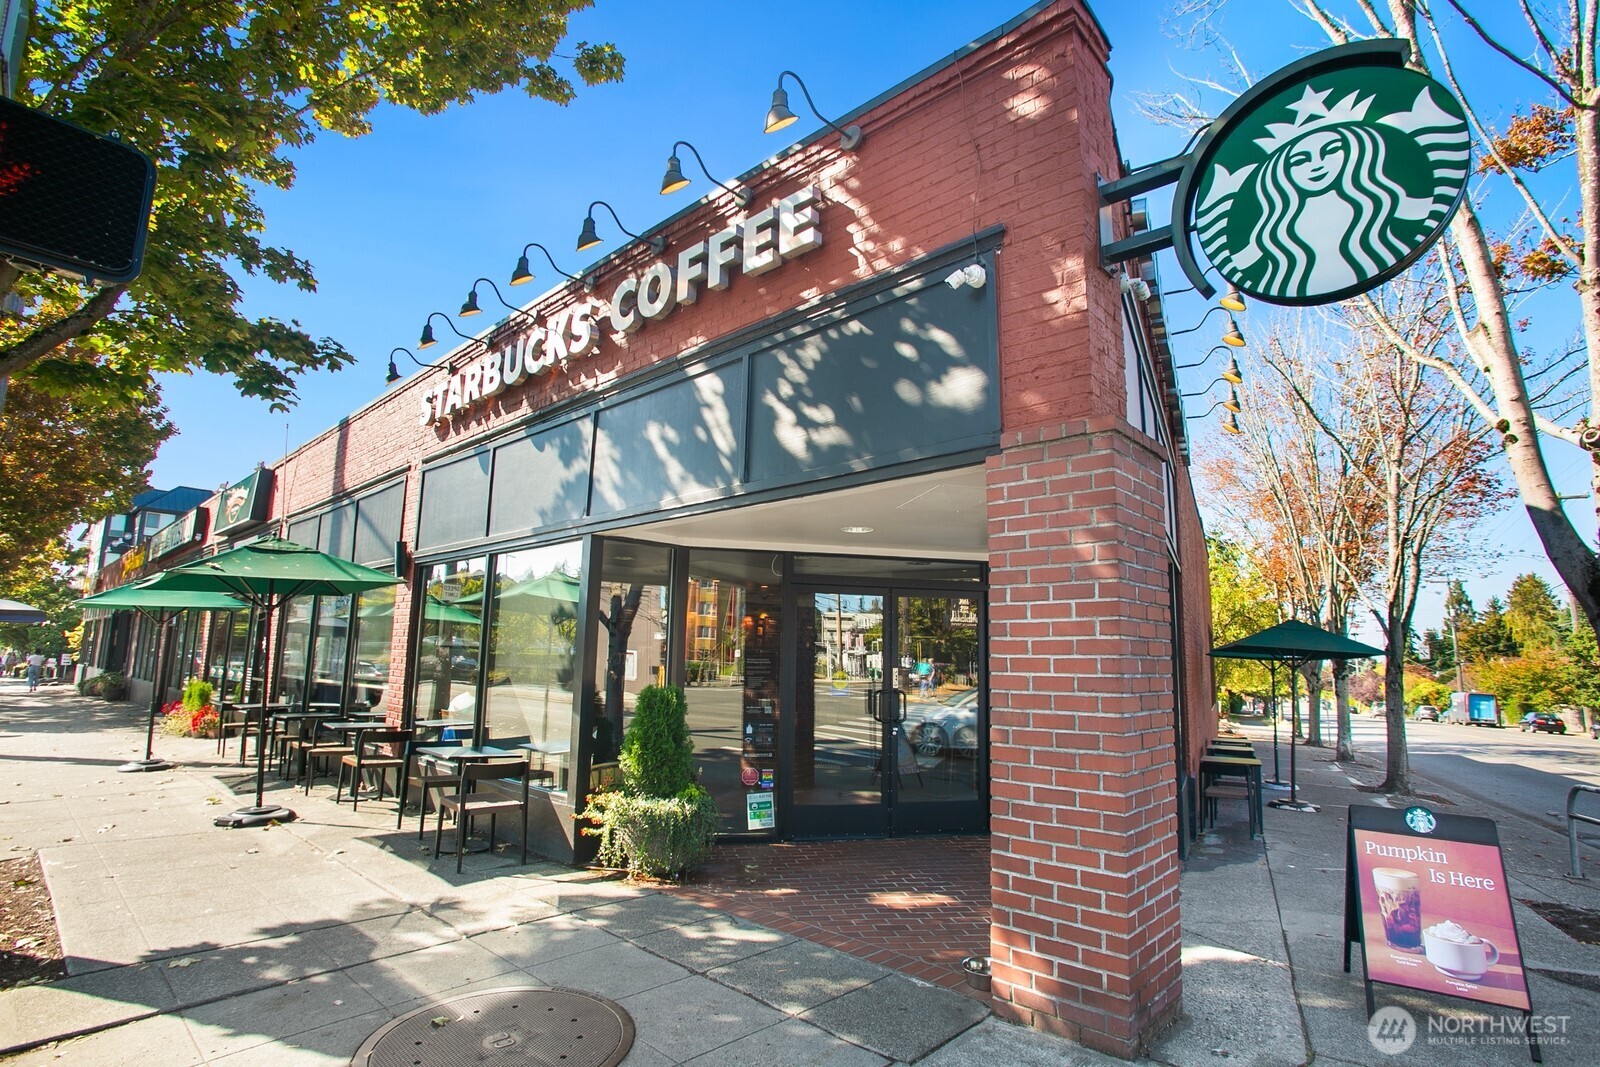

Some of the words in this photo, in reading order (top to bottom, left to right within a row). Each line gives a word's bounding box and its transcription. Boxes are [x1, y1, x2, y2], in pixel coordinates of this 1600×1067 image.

[419, 302, 600, 427] STARBUCKS
[610, 185, 822, 333] COFFEE
[1365, 841, 1448, 864] Pumpkin
[1429, 868, 1446, 884] Is
[1450, 871, 1495, 891] Here
